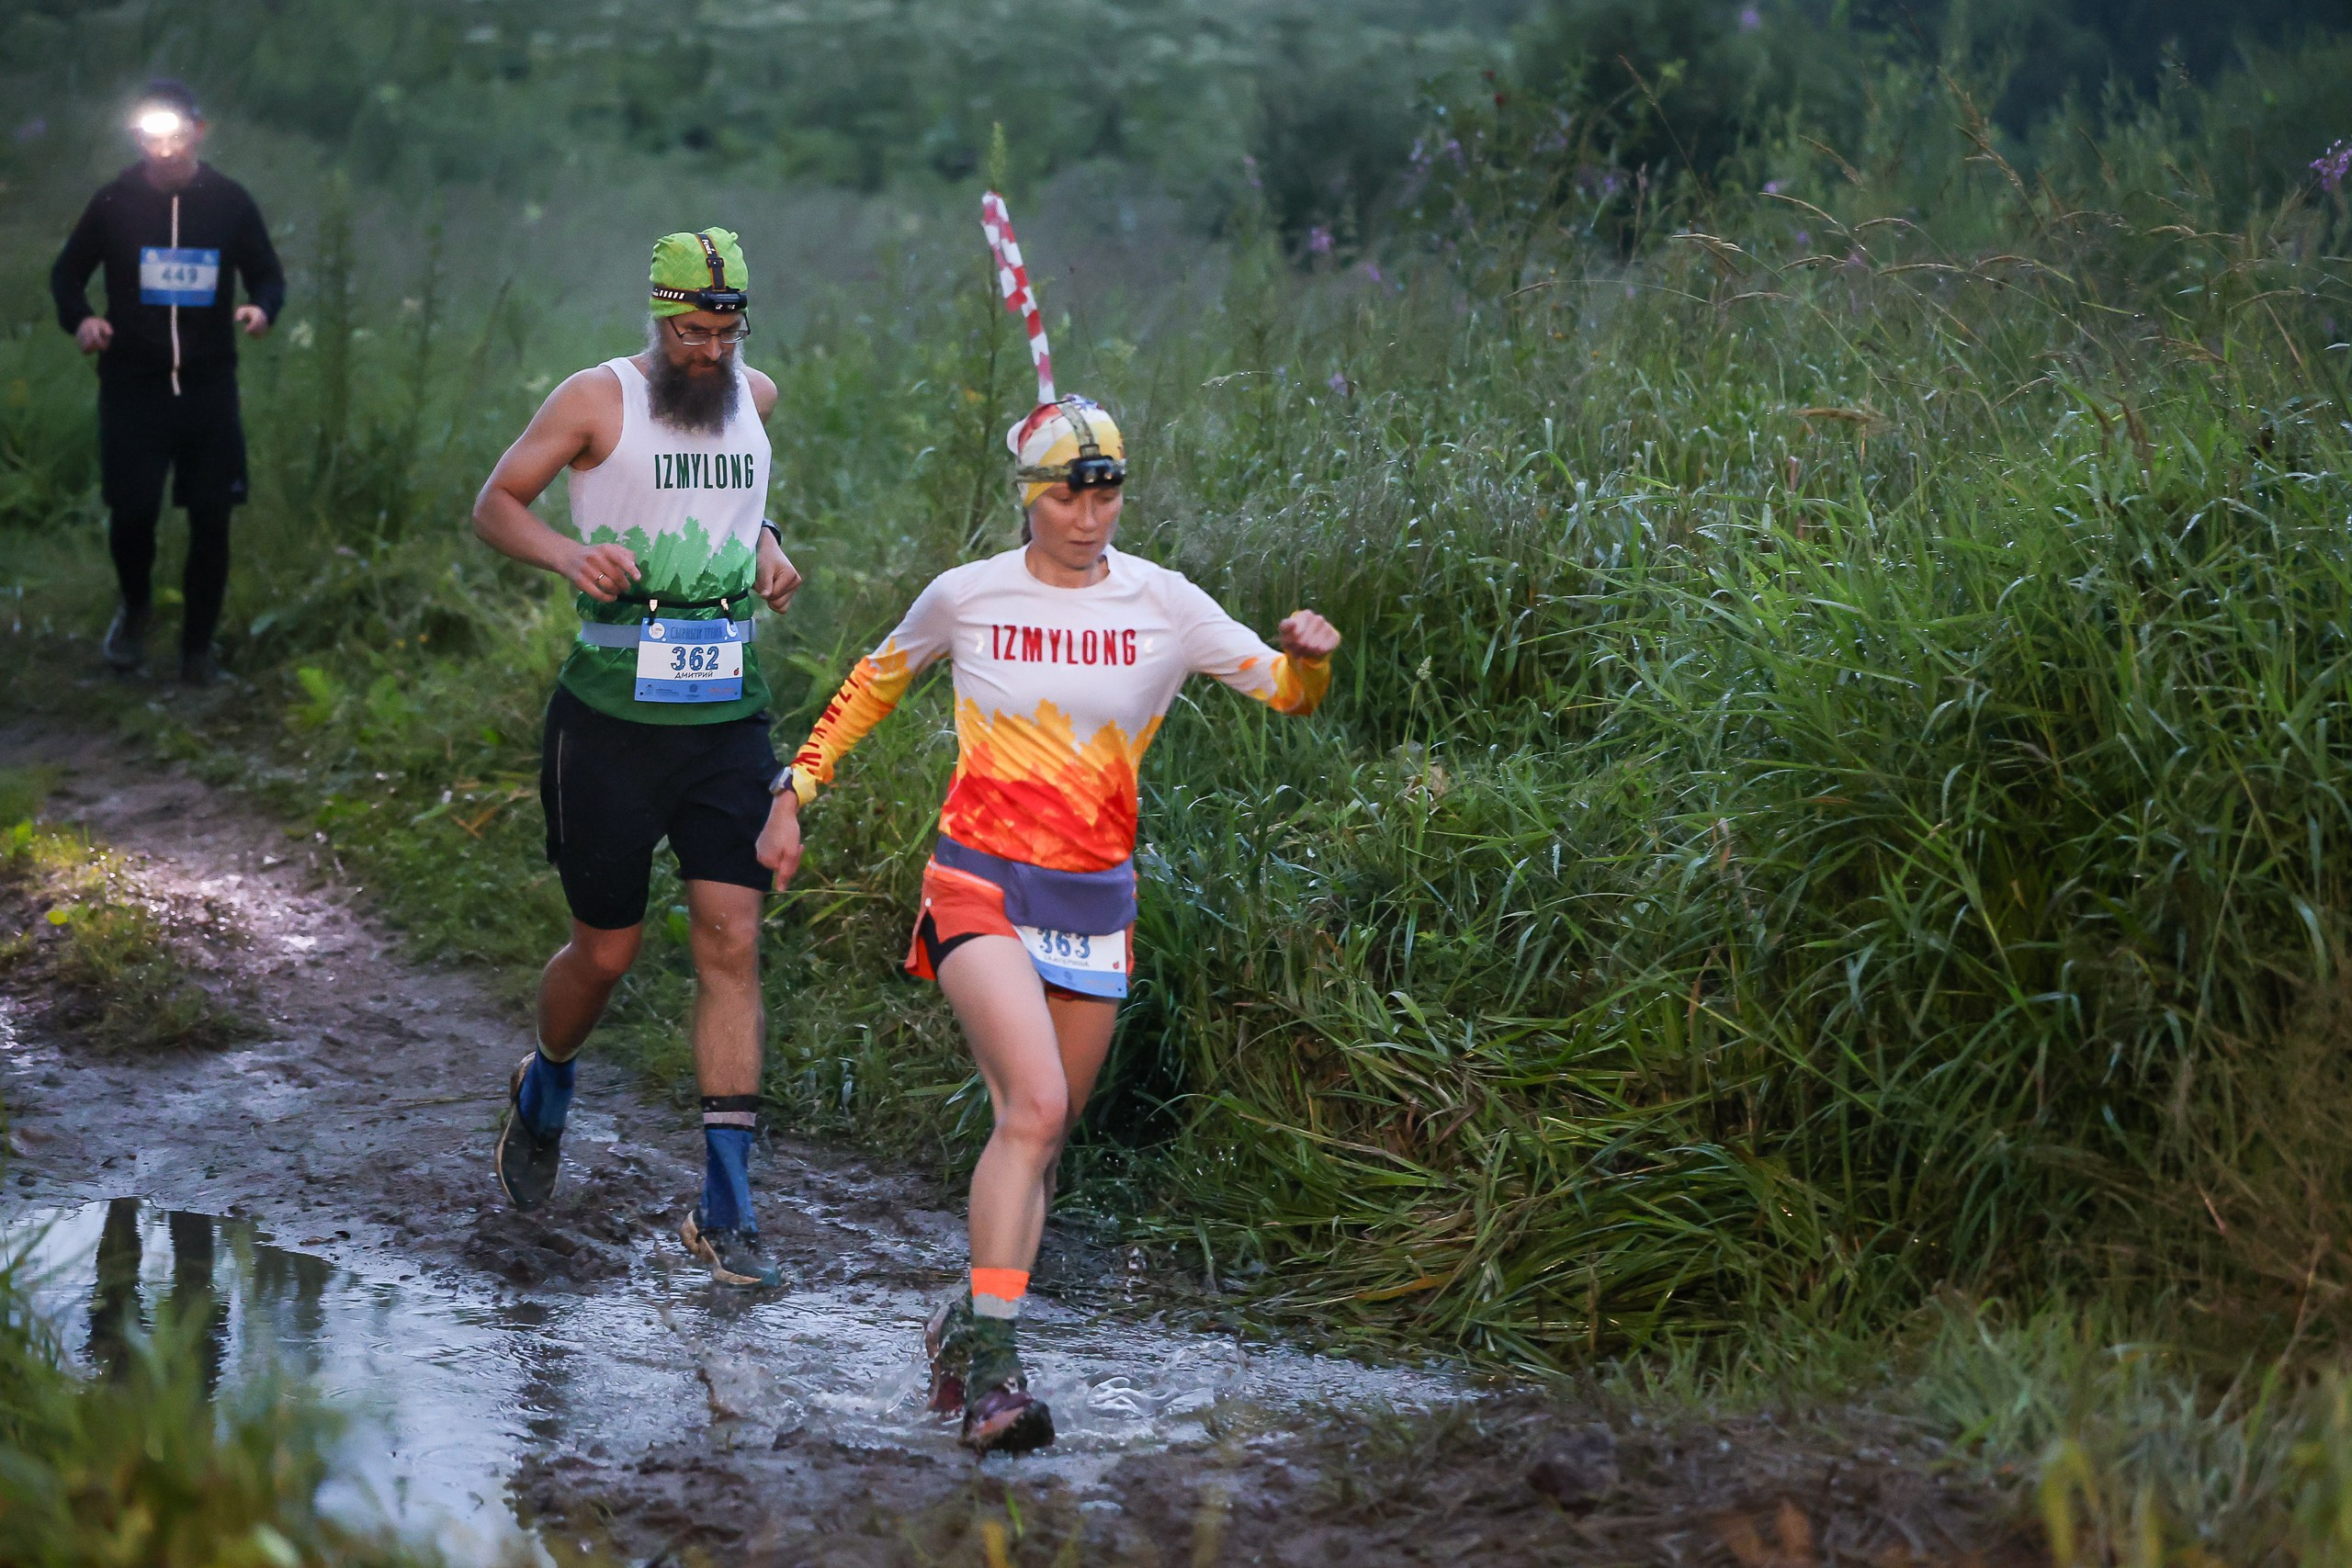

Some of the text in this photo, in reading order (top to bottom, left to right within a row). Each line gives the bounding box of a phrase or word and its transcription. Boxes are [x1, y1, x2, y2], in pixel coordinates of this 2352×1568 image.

[654, 453, 753, 490] IZMYLONG
[671, 646, 719, 671] 362
[992, 625, 1136, 665] IZMYLONG
[673, 670, 713, 679] ДМИТРИЙ
[1036, 928, 1091, 958] 363
